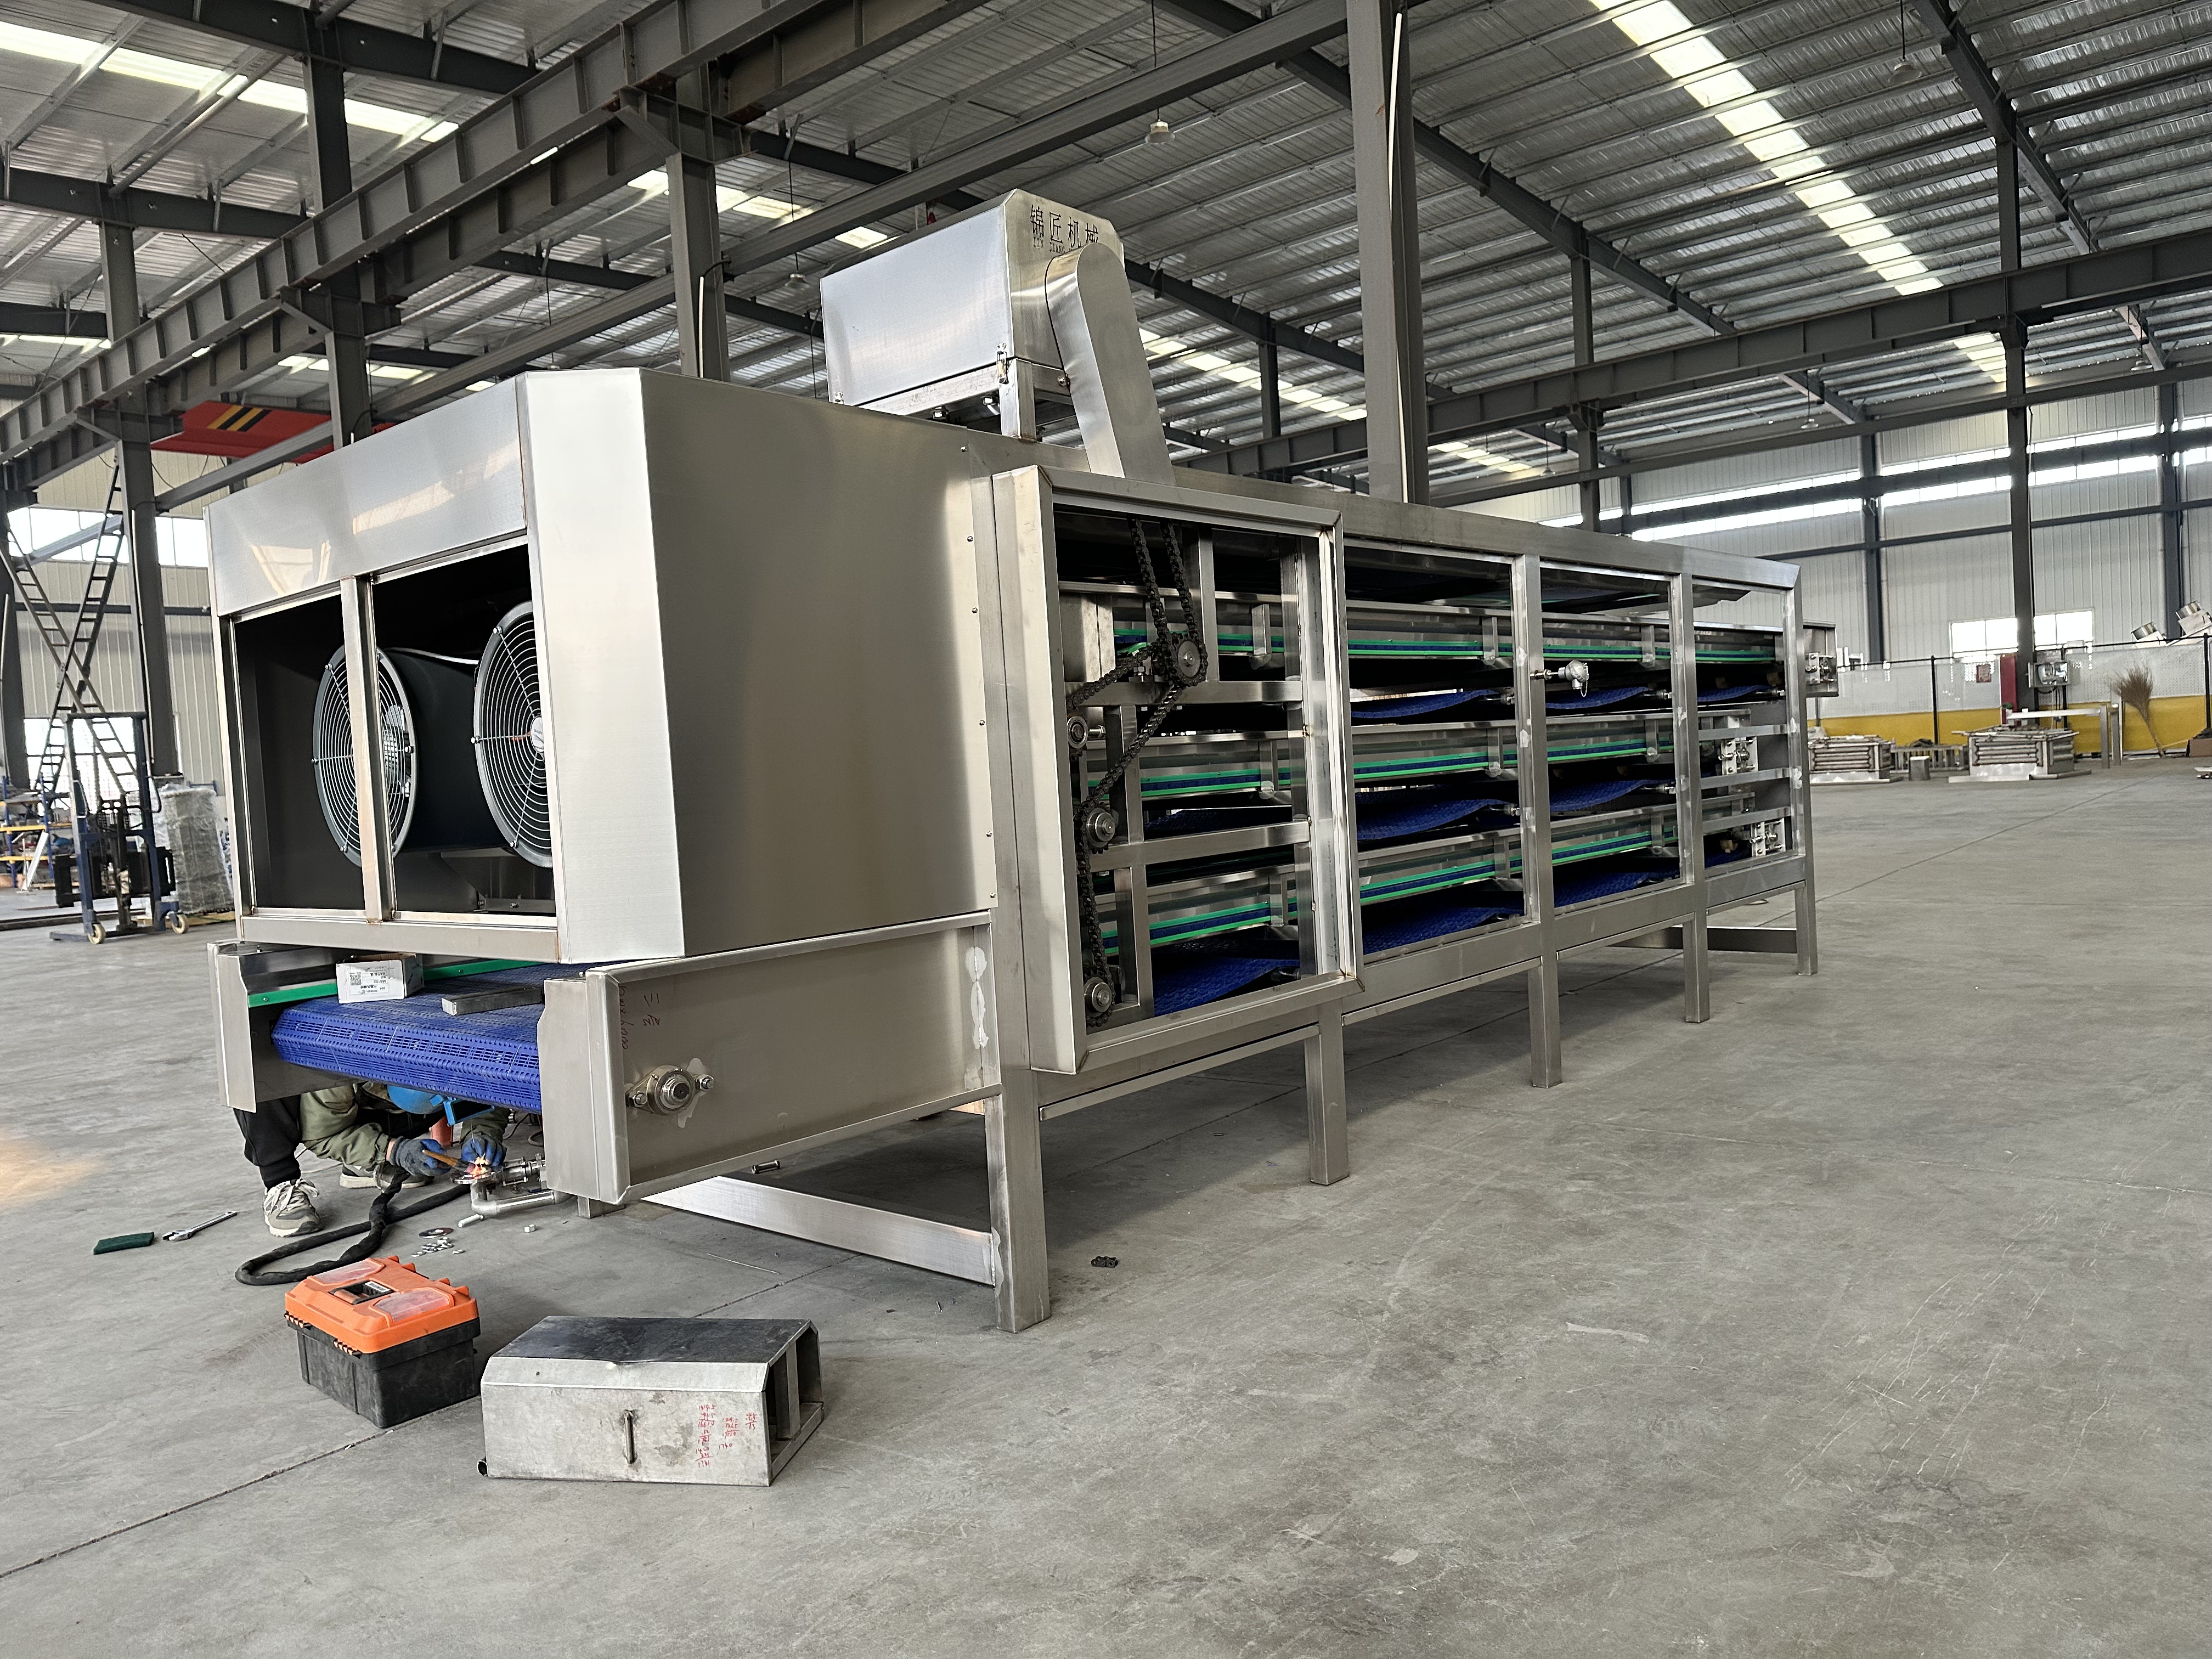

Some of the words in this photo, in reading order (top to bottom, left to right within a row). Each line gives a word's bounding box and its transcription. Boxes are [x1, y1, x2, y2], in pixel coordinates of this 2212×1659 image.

[1030, 204, 1098, 248] 锦匠机械
[1033, 237, 1044, 249] JIN
[698, 1460, 710, 1468] 1741
